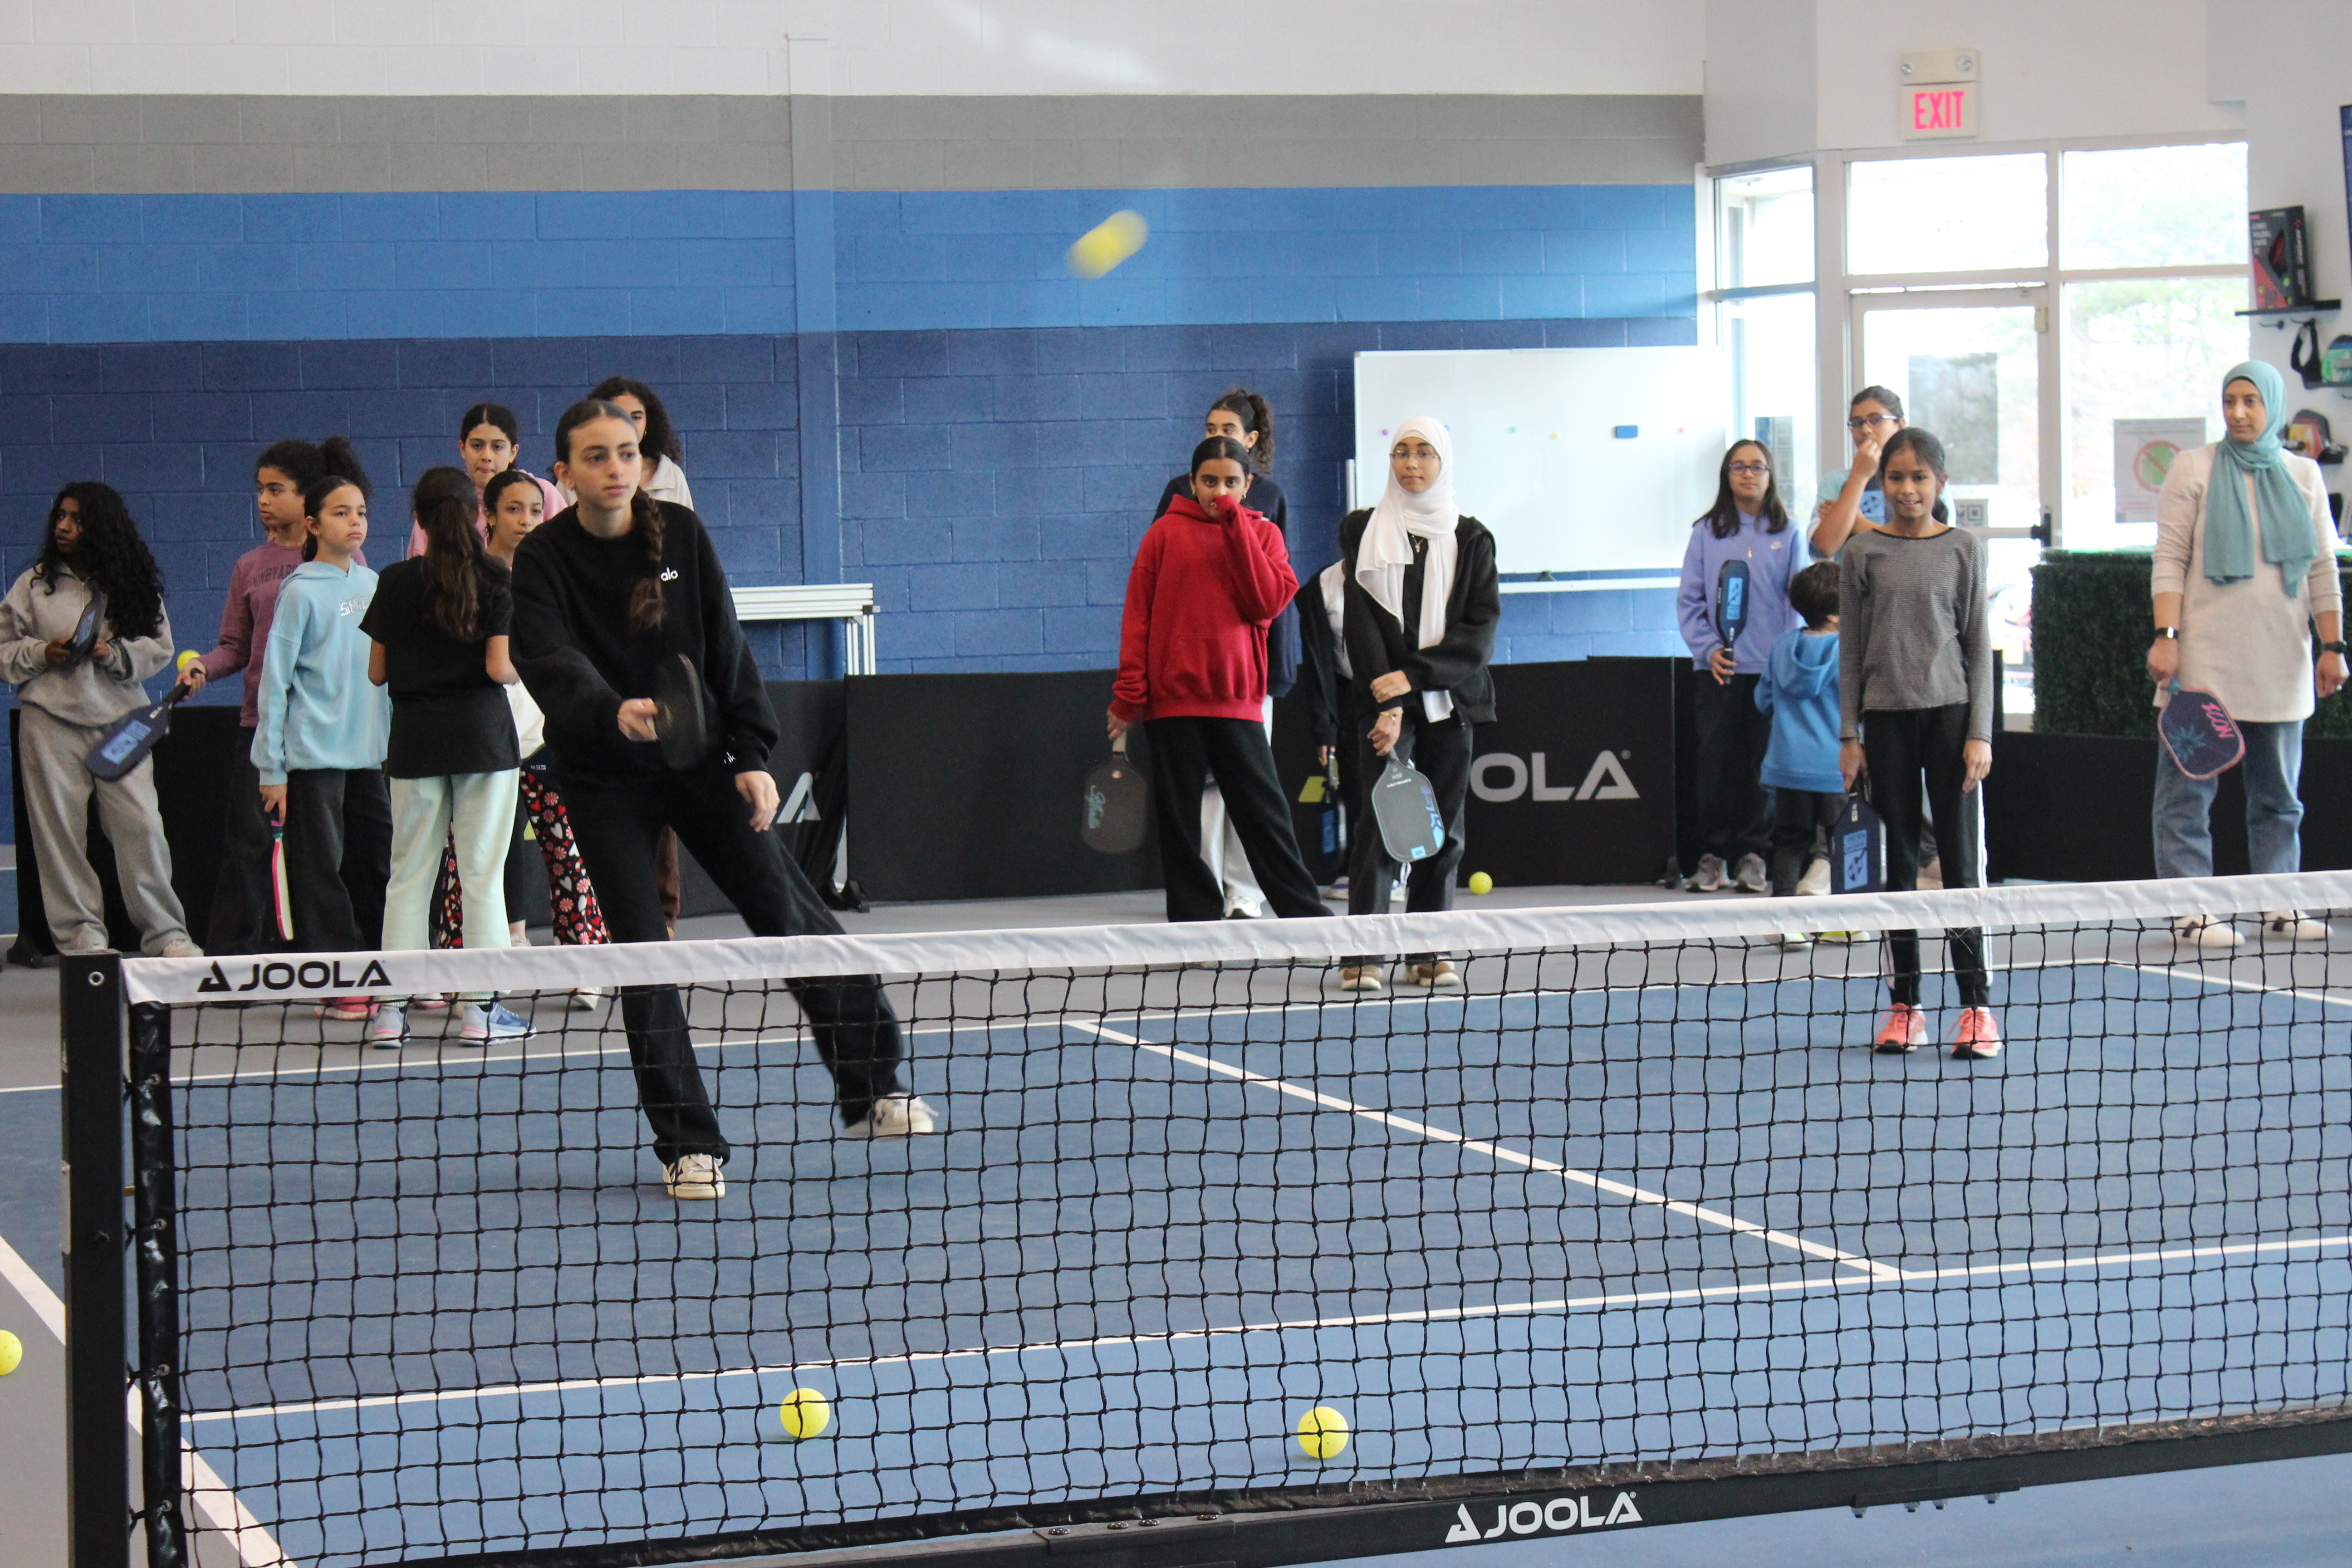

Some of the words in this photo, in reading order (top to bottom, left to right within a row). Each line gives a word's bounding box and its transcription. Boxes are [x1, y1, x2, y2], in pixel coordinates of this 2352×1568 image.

[1914, 90, 1965, 130] EXIT
[660, 567, 678, 582] alo
[238, 959, 392, 991] JOOLA
[1483, 1491, 1643, 1539] JOOLA
